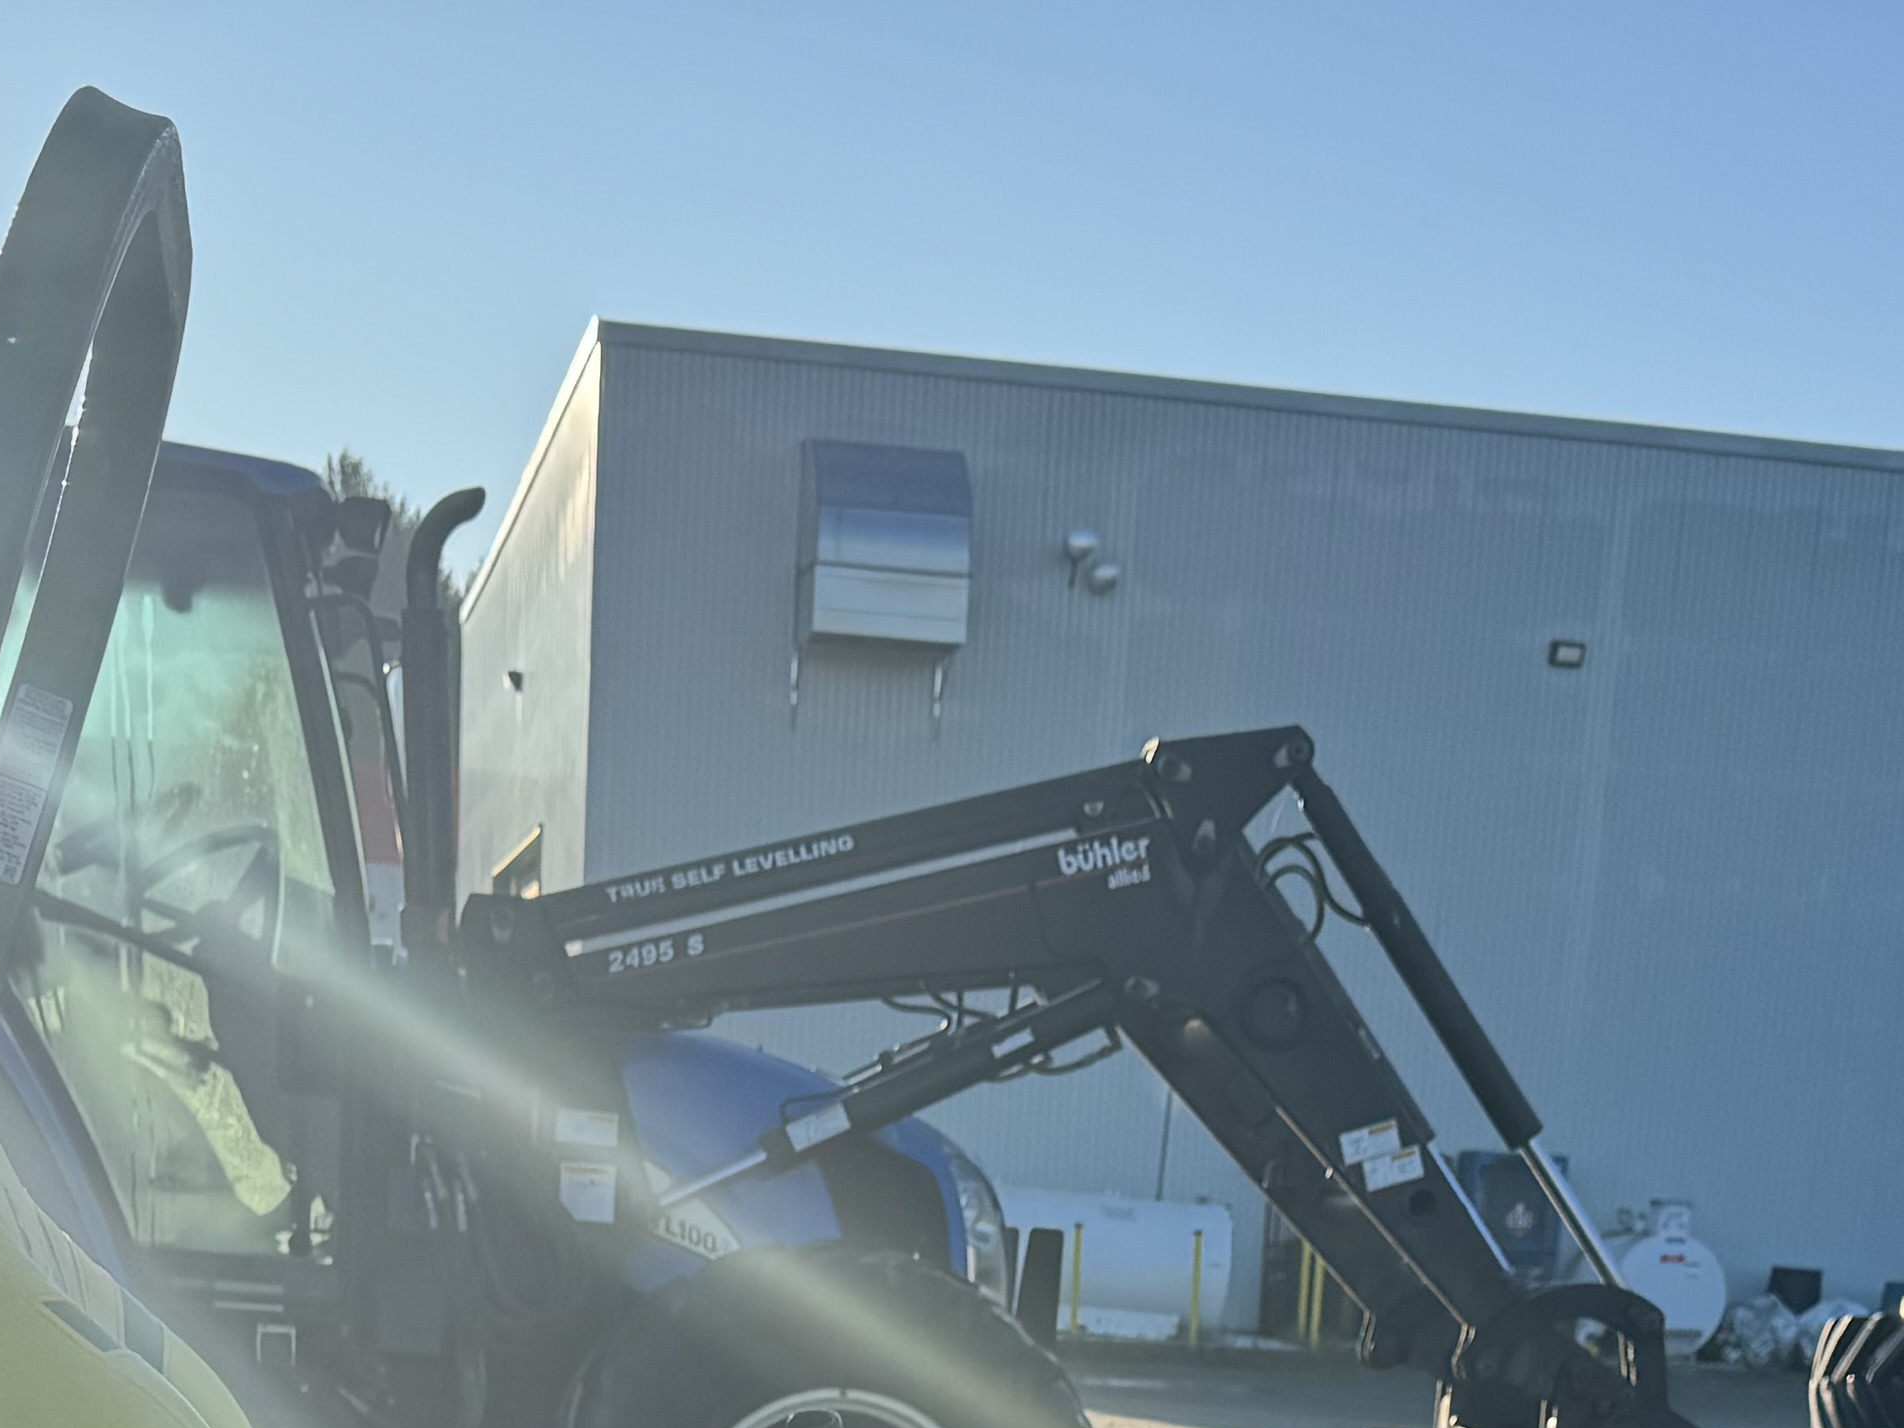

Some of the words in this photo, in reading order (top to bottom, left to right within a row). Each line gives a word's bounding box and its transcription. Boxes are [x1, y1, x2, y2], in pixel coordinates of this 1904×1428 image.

[607, 873, 667, 904] TRUE
[670, 861, 727, 892] SELF
[732, 834, 856, 877] LEVELLING
[1058, 834, 1152, 878] bühler
[607, 938, 676, 974] 2495
